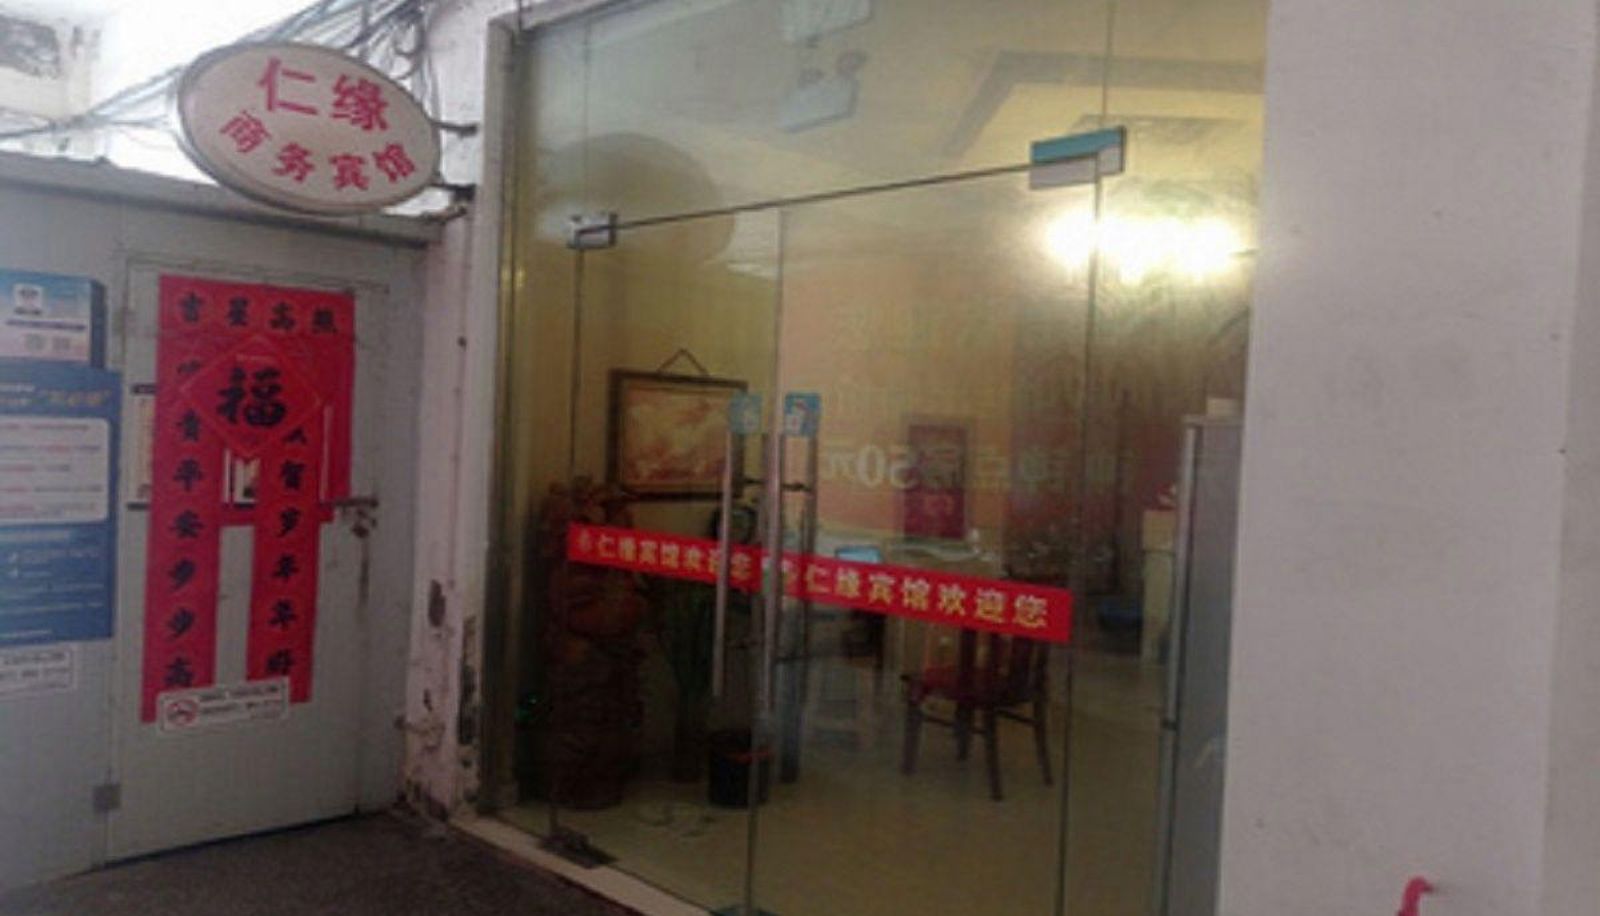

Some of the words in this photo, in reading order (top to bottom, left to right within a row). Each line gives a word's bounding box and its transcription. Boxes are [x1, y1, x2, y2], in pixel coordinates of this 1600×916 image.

[257, 57, 389, 131] 仁缘
[219, 109, 416, 191] 商务宾馆
[178, 291, 339, 335] 吉星高照
[216, 365, 287, 427] 福
[804, 564, 1048, 628] 仁缘宾馆欢迎您
